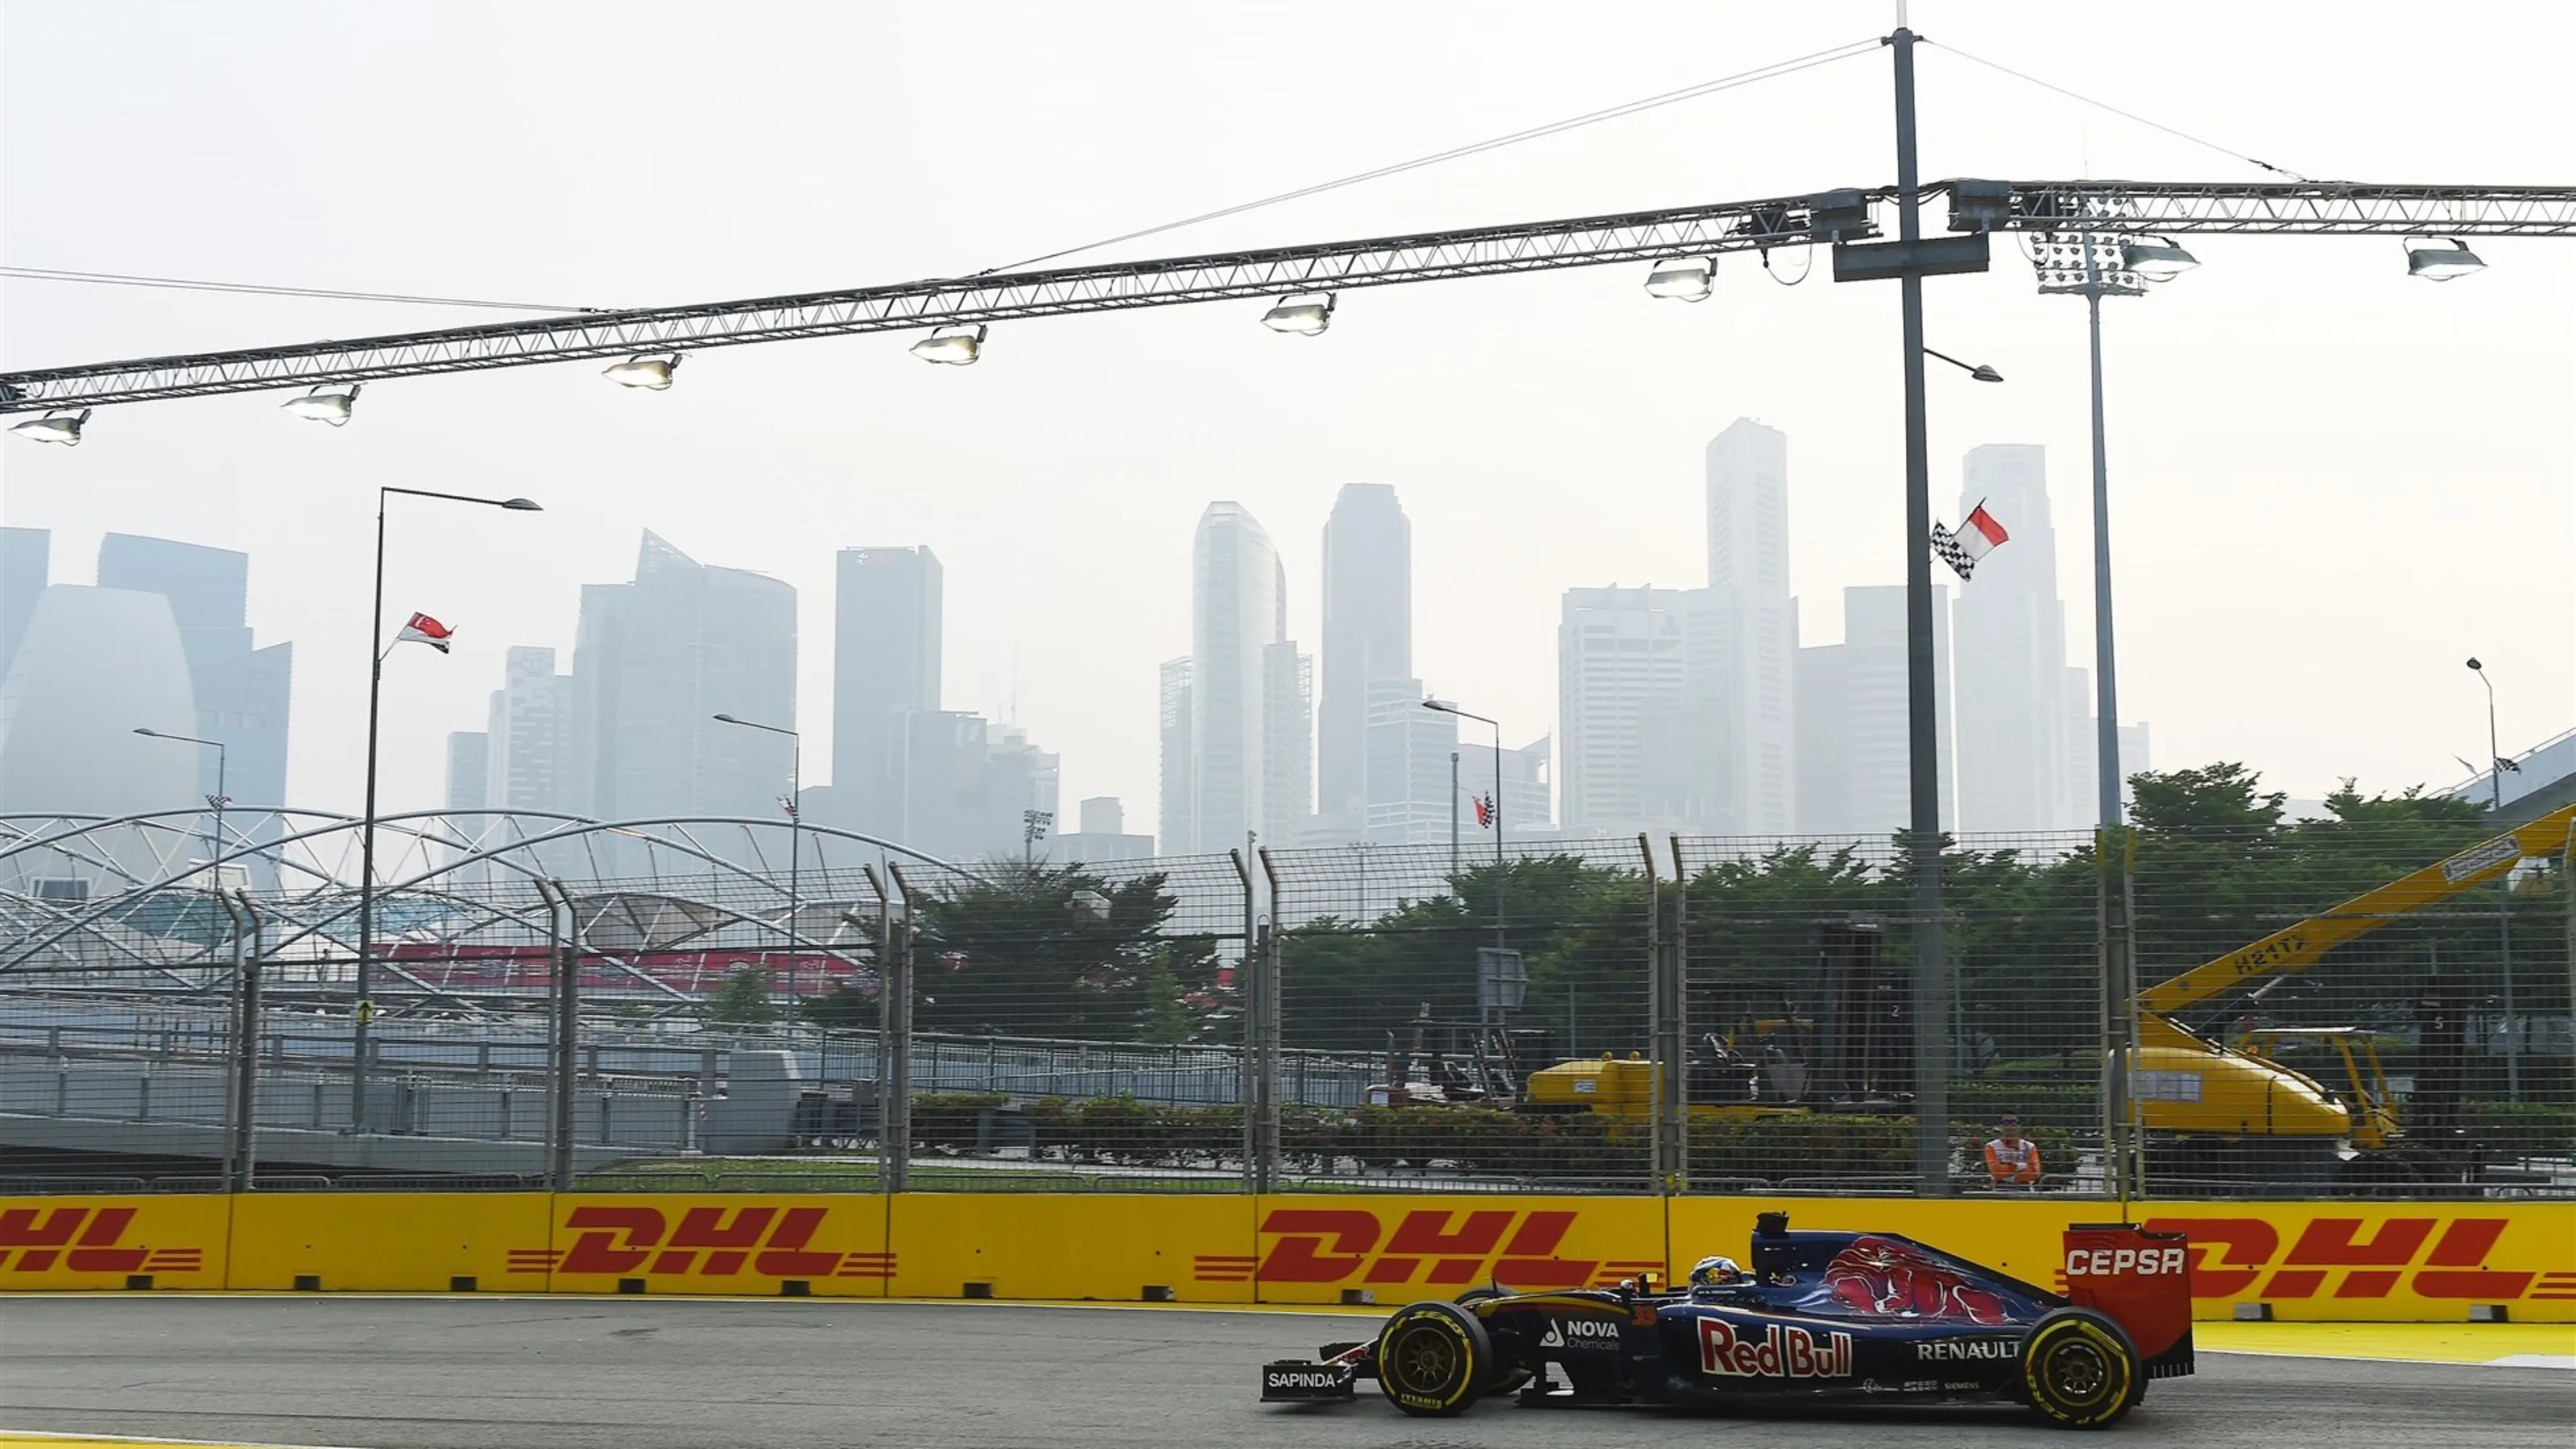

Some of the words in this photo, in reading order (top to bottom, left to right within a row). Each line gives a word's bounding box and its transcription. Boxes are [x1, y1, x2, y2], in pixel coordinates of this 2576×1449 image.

[2434, 1016, 2444, 1030] 5
[0, 1208, 150, 1272] HL
[557, 1207, 844, 1275] DHL
[1258, 1210, 1599, 1286] DHL
[2065, 1249, 2185, 1275] CEPSA
[2142, 1218, 2537, 1299] DHL
[1567, 1320, 1620, 1338] NOVA
[1567, 1336, 1621, 1352] Chemicals
[1697, 1316, 1784, 1377] Red
[1785, 1326, 1851, 1377] Bull
[1917, 1340, 2021, 1360] RENAULT
[1268, 1373, 1336, 1388] SAPINDA
[1945, 1381, 1980, 1390] SIEMENS
